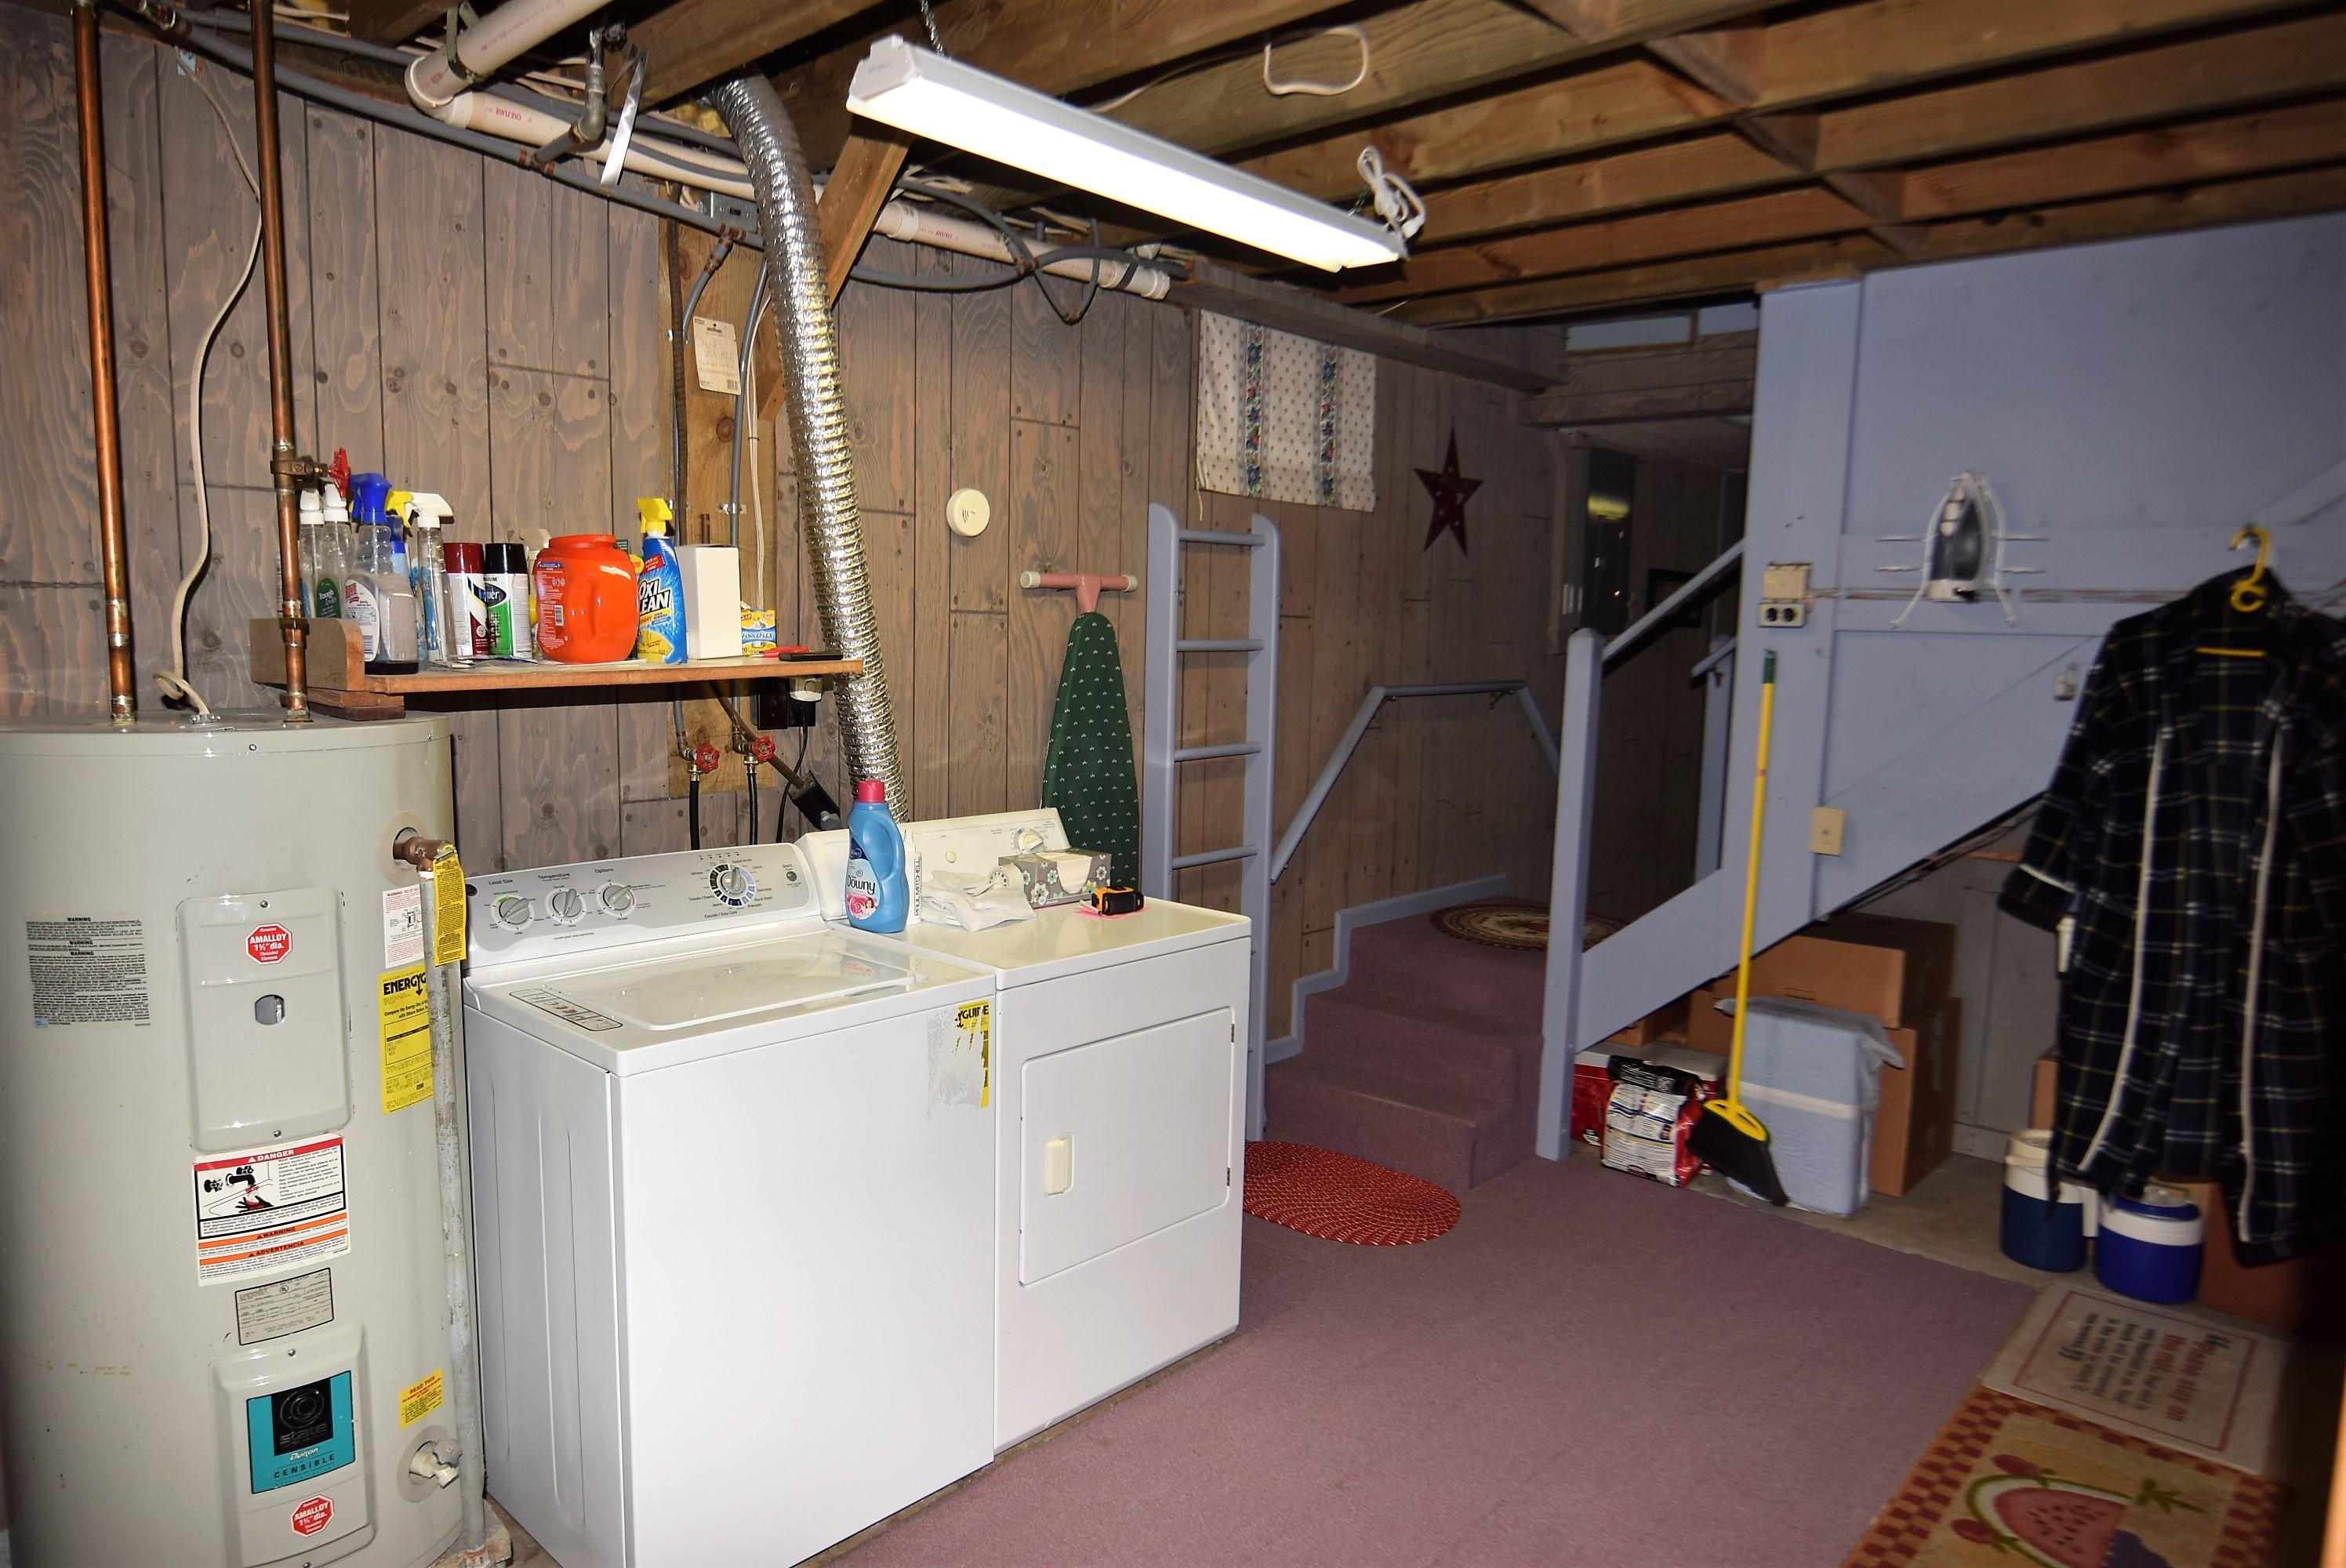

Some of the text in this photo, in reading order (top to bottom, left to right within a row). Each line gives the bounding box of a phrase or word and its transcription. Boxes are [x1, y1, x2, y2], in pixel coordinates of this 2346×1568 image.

[319, 590, 334, 600] Tough
[639, 579, 659, 601] OXI
[640, 590, 671, 614] LEAN
[848, 875, 875, 895] Downy
[250, 933, 287, 944] AMALLOY
[383, 972, 427, 996] ENERGYG
[258, 1149, 294, 1161] DANGER
[263, 1227, 296, 1238] WARNING
[256, 1241, 305, 1256] ADVERTENCIA
[274, 1454, 334, 1478] CENSIBLE
[295, 1502, 329, 1521] AMALLOY
